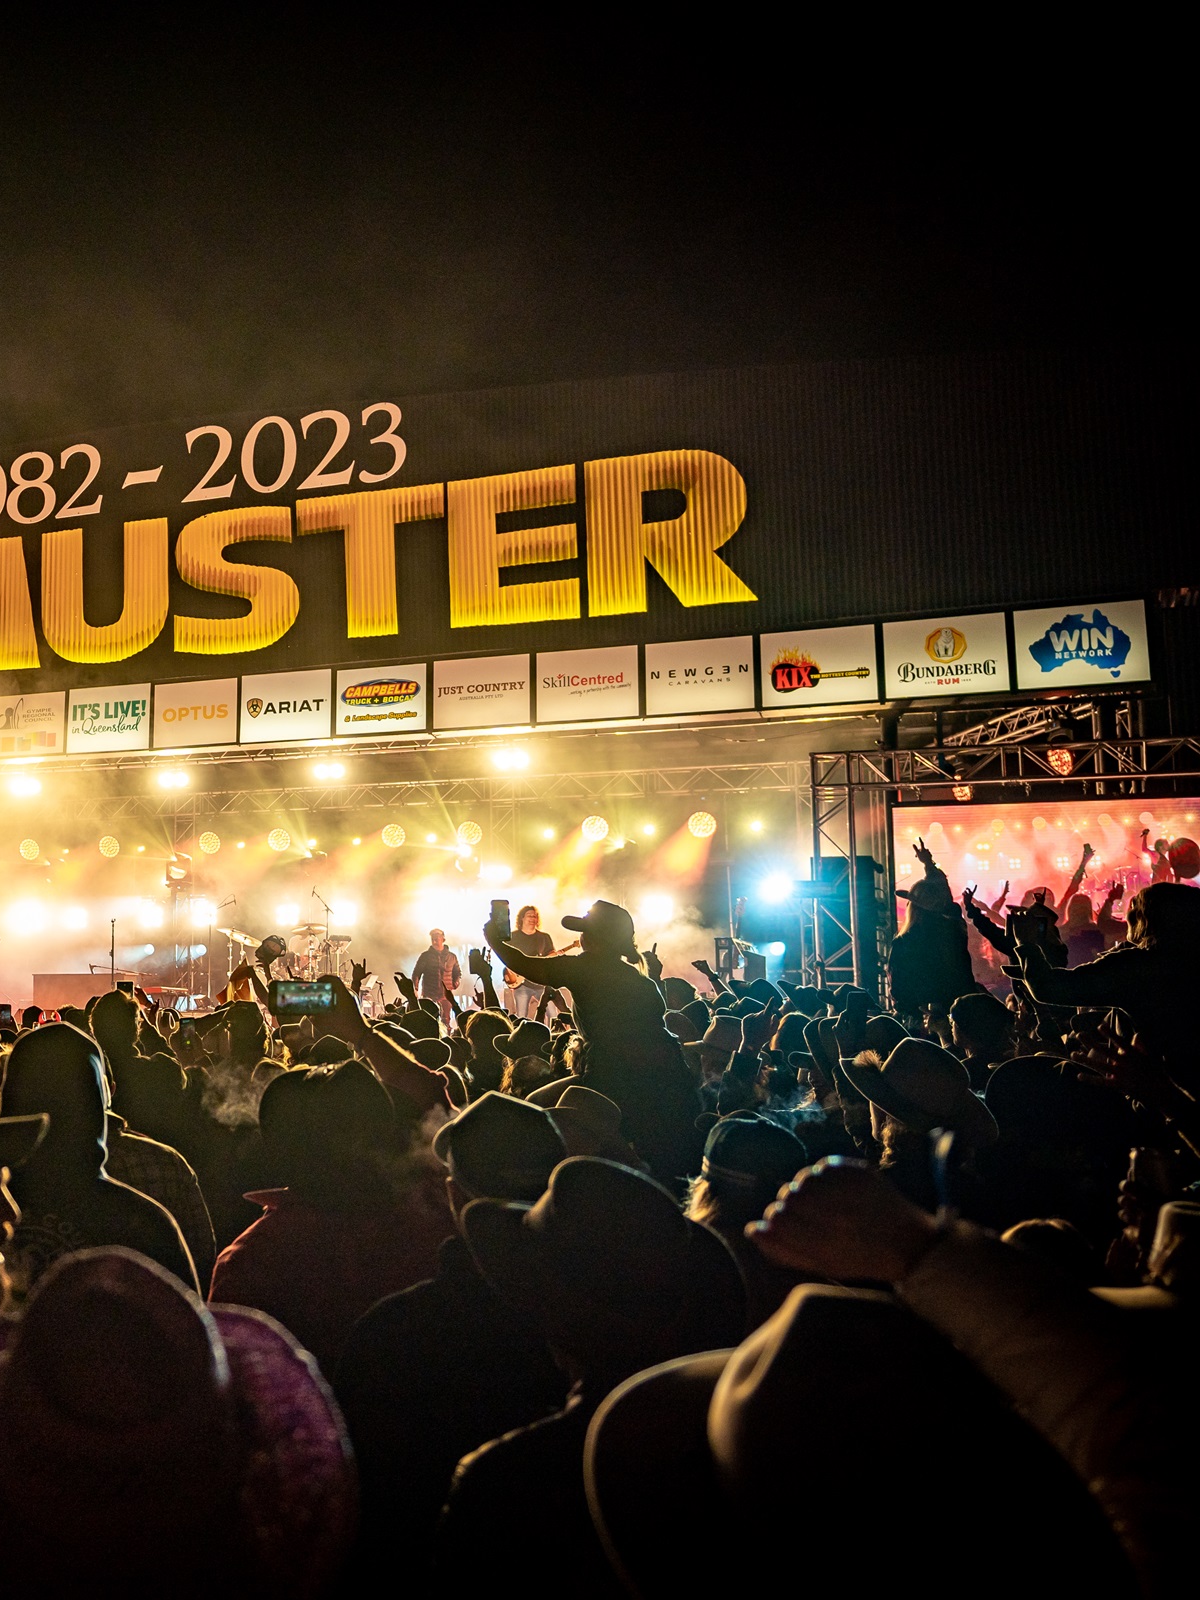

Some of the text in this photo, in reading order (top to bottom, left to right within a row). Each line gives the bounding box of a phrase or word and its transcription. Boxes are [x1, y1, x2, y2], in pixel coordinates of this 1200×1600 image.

[181, 402, 408, 503] 2023
[1049, 626, 1114, 652] WIN
[1055, 649, 1112, 659] NETWORK
[775, 667, 813, 689] KIX
[897, 659, 996, 683] BUNDABERG
[345, 681, 418, 698] CAMPBELLS
[437, 681, 526, 698] JUST COUNTRY
[668, 677, 731, 686] CARAVANS
[263, 698, 325, 715] ARIAT
[346, 697, 372, 706] TRUCK
[382, 694, 415, 703] BOBCAT
[72, 699, 146, 721] IT'S LIVE!
[162, 703, 228, 723] OPTUS
[352, 713, 387, 722] Landscape
[388, 710, 417, 721] Supplies
[82, 713, 141, 735] Queensland
